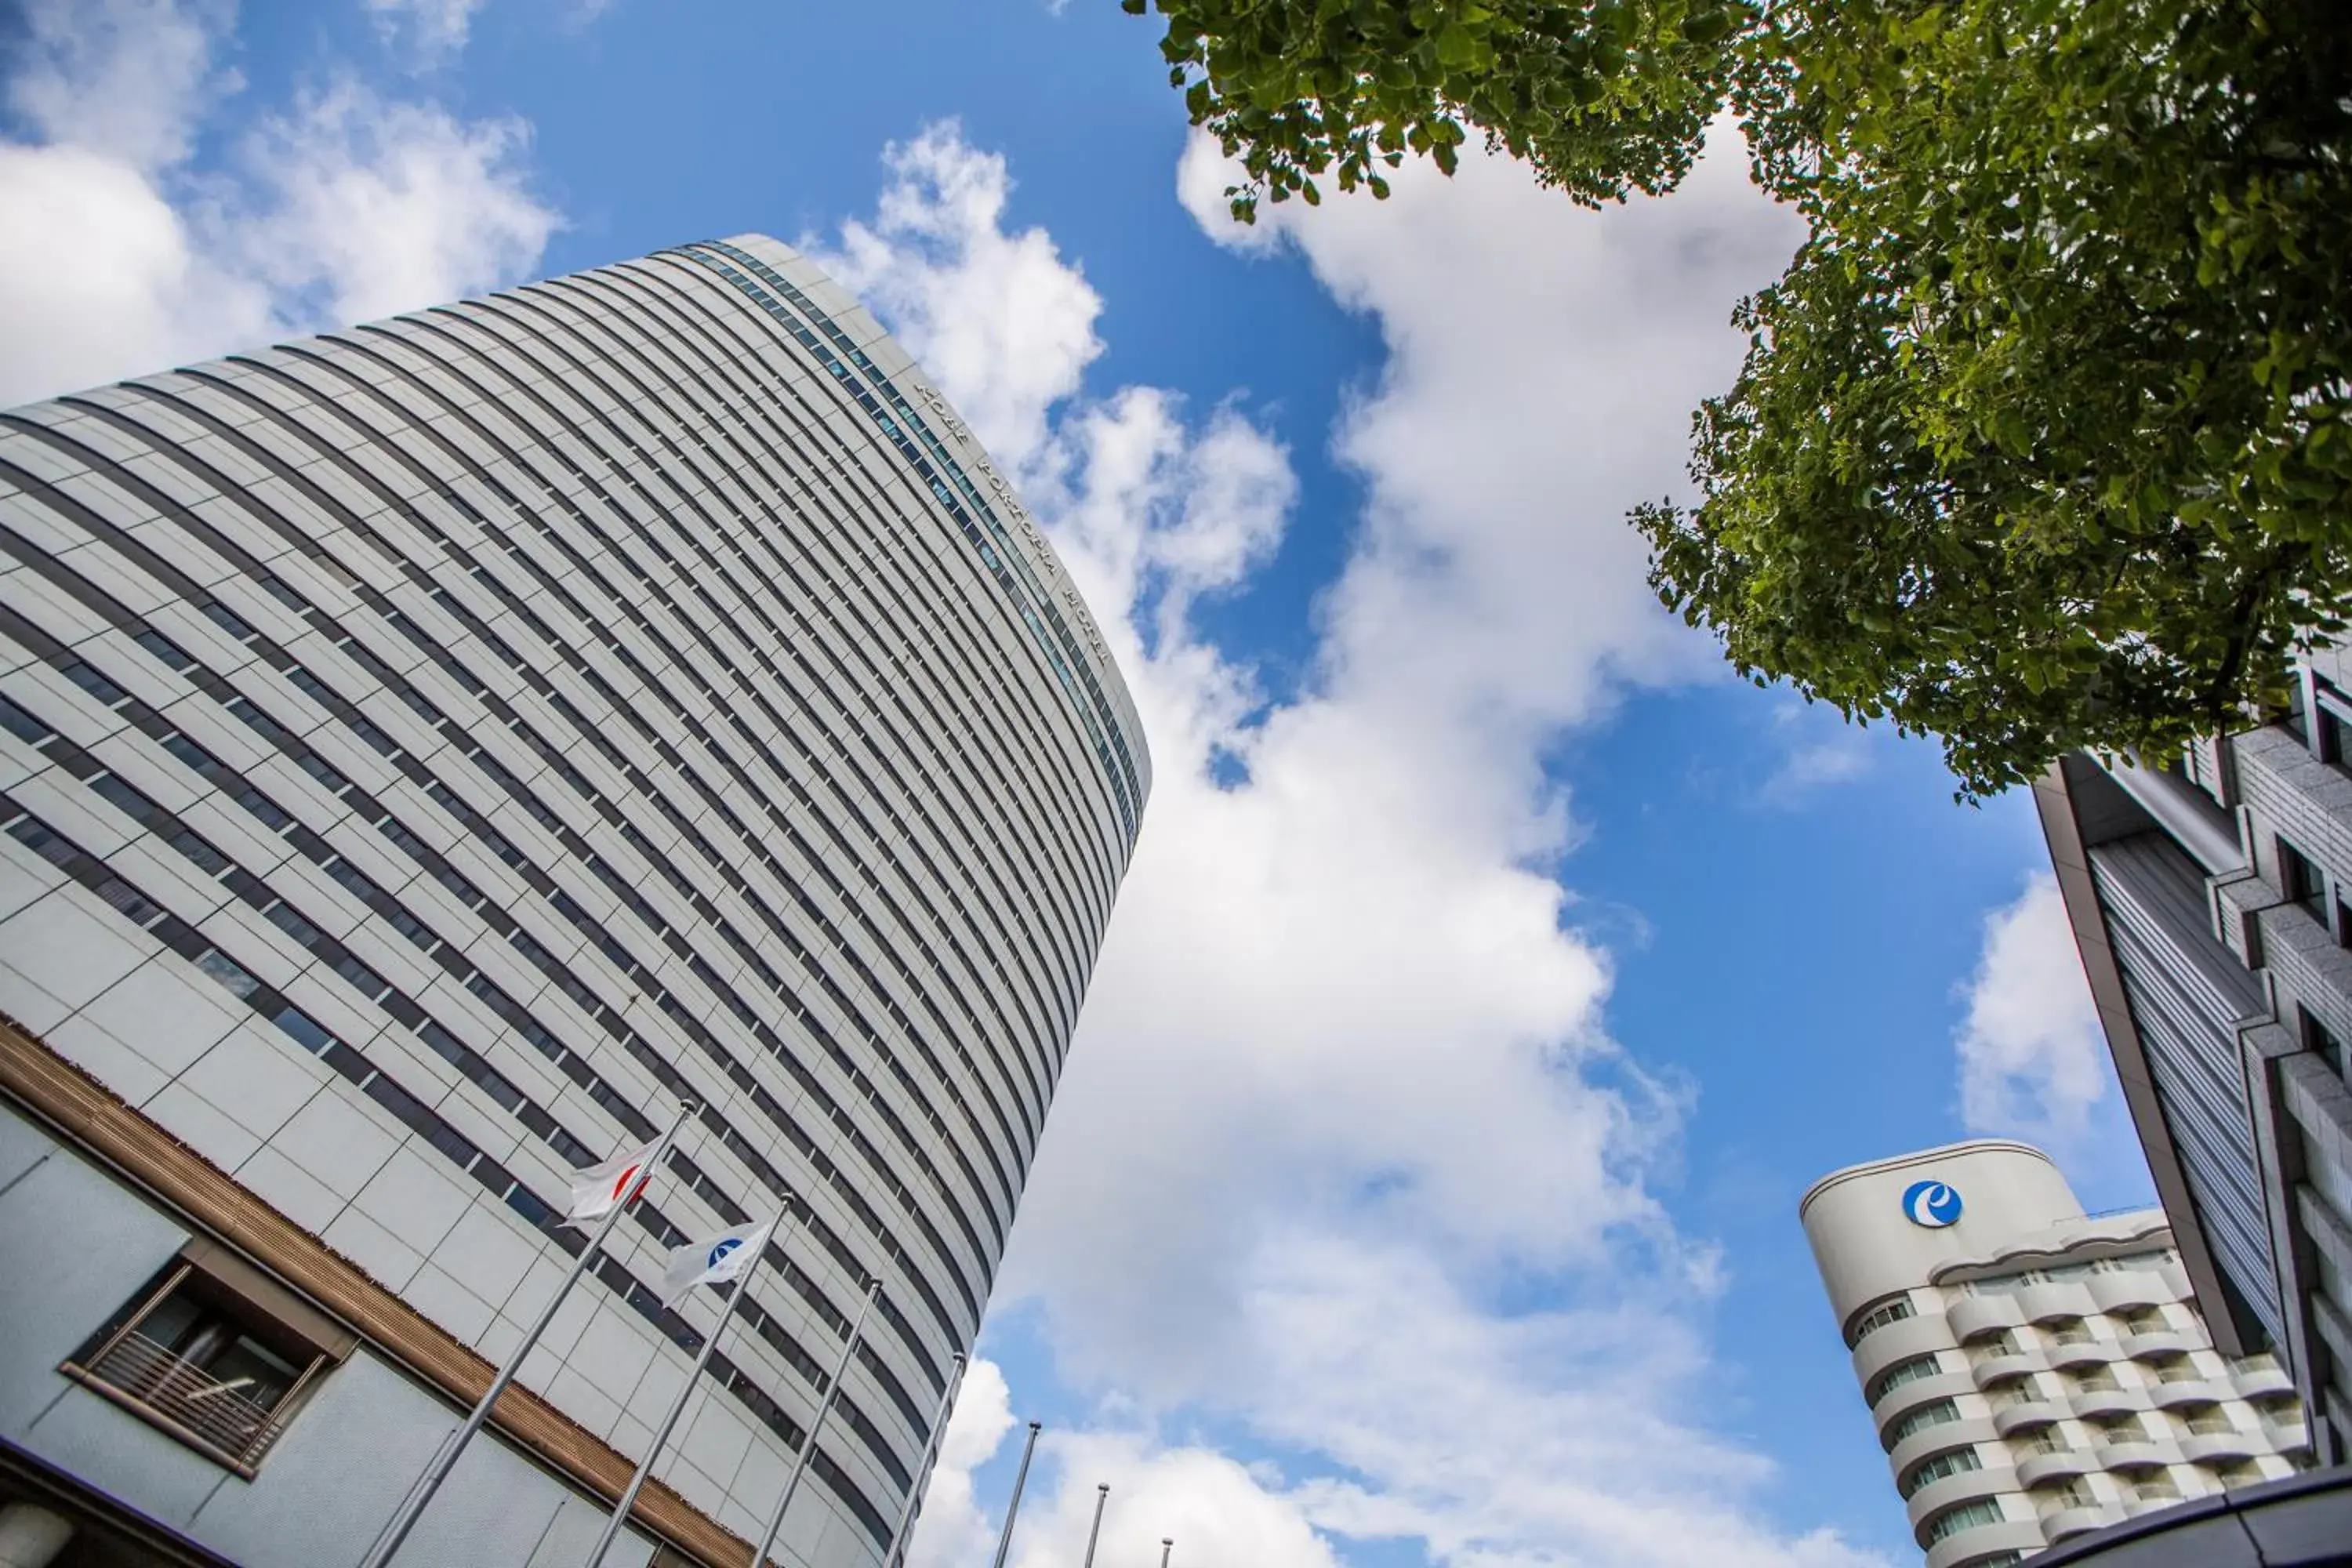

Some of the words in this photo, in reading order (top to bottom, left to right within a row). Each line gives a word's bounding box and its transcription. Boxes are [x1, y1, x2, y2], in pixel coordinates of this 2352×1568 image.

[913, 383, 968, 446] KOBE
[977, 462, 1057, 576] PORTOPIA
[1062, 589, 1108, 667] HOTEL
